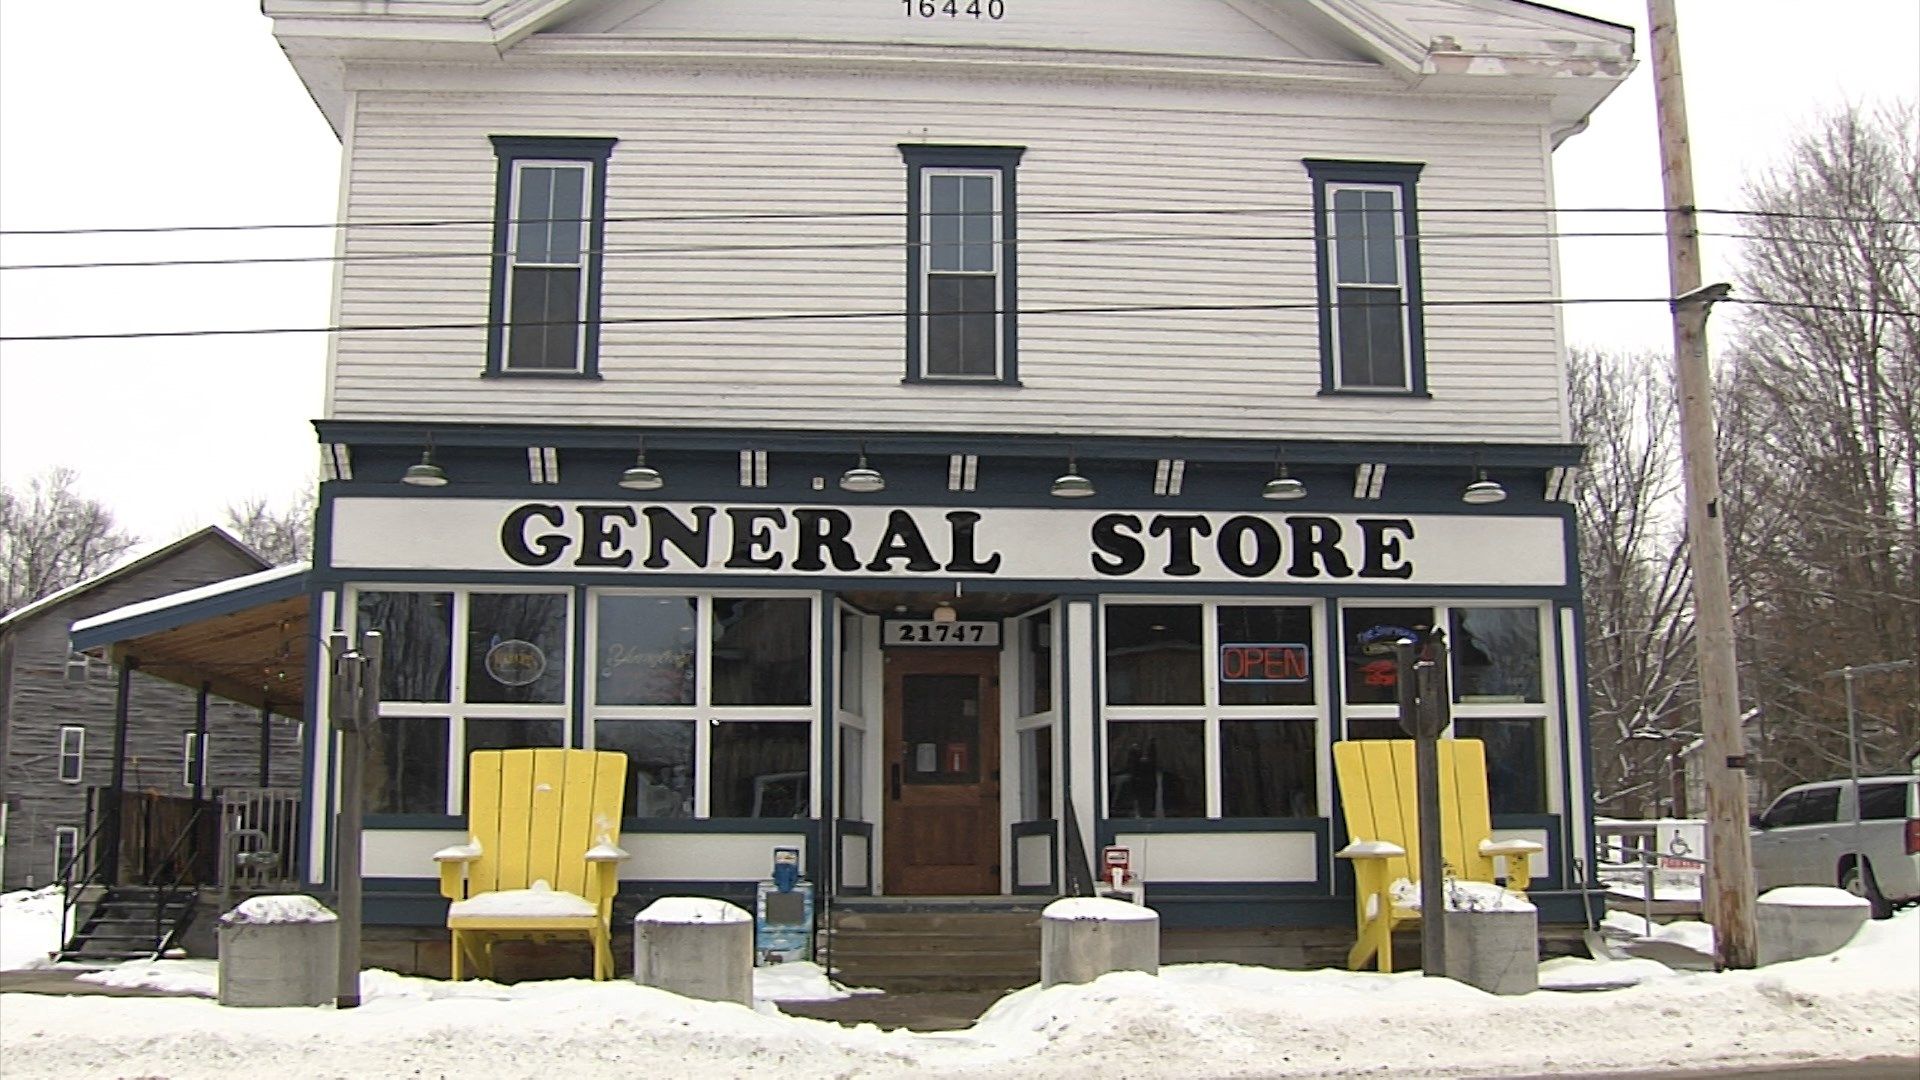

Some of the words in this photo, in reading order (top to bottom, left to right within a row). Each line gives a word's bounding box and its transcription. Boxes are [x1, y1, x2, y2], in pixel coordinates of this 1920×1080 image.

[902, 0, 1004, 19] 16440
[501, 503, 1001, 574] GENERAL
[1091, 513, 1415, 579] STORE
[899, 624, 984, 642] 21747
[1224, 648, 1306, 679] OPEN
